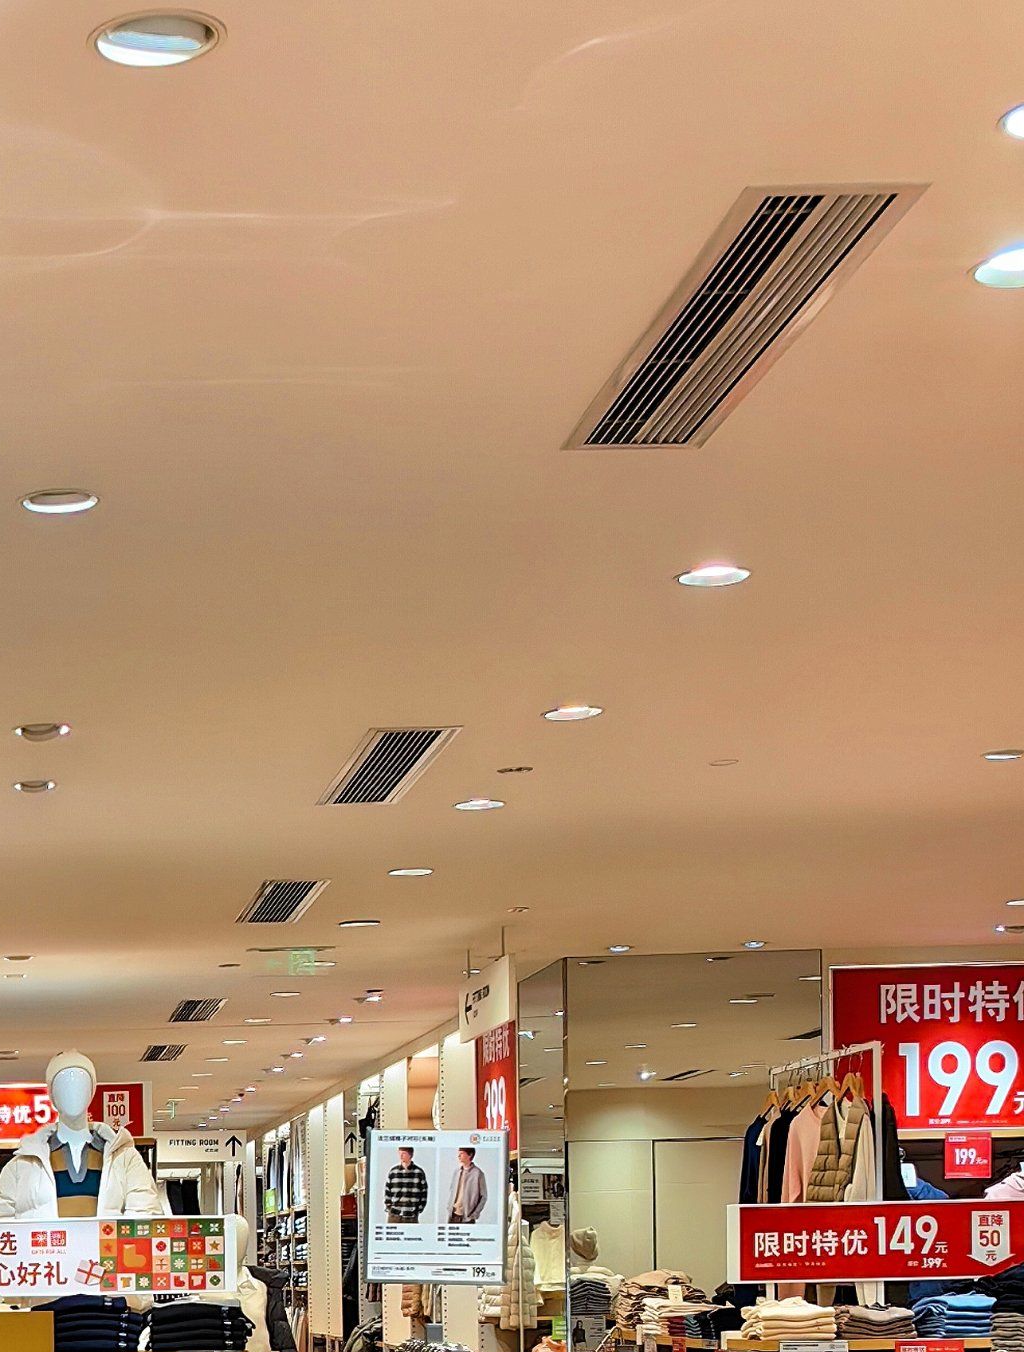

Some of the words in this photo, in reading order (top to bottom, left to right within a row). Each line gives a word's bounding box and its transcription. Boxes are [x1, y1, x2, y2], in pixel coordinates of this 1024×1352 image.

[880, 981, 1024, 1024] 限时特
[108, 1104, 125, 1116] 100
[978, 1214, 1003, 1226] 直降
[754, 1229, 868, 1258] 限时特优
[979, 1230, 1000, 1247] 50
[985, 1250, 996, 1261] 元
